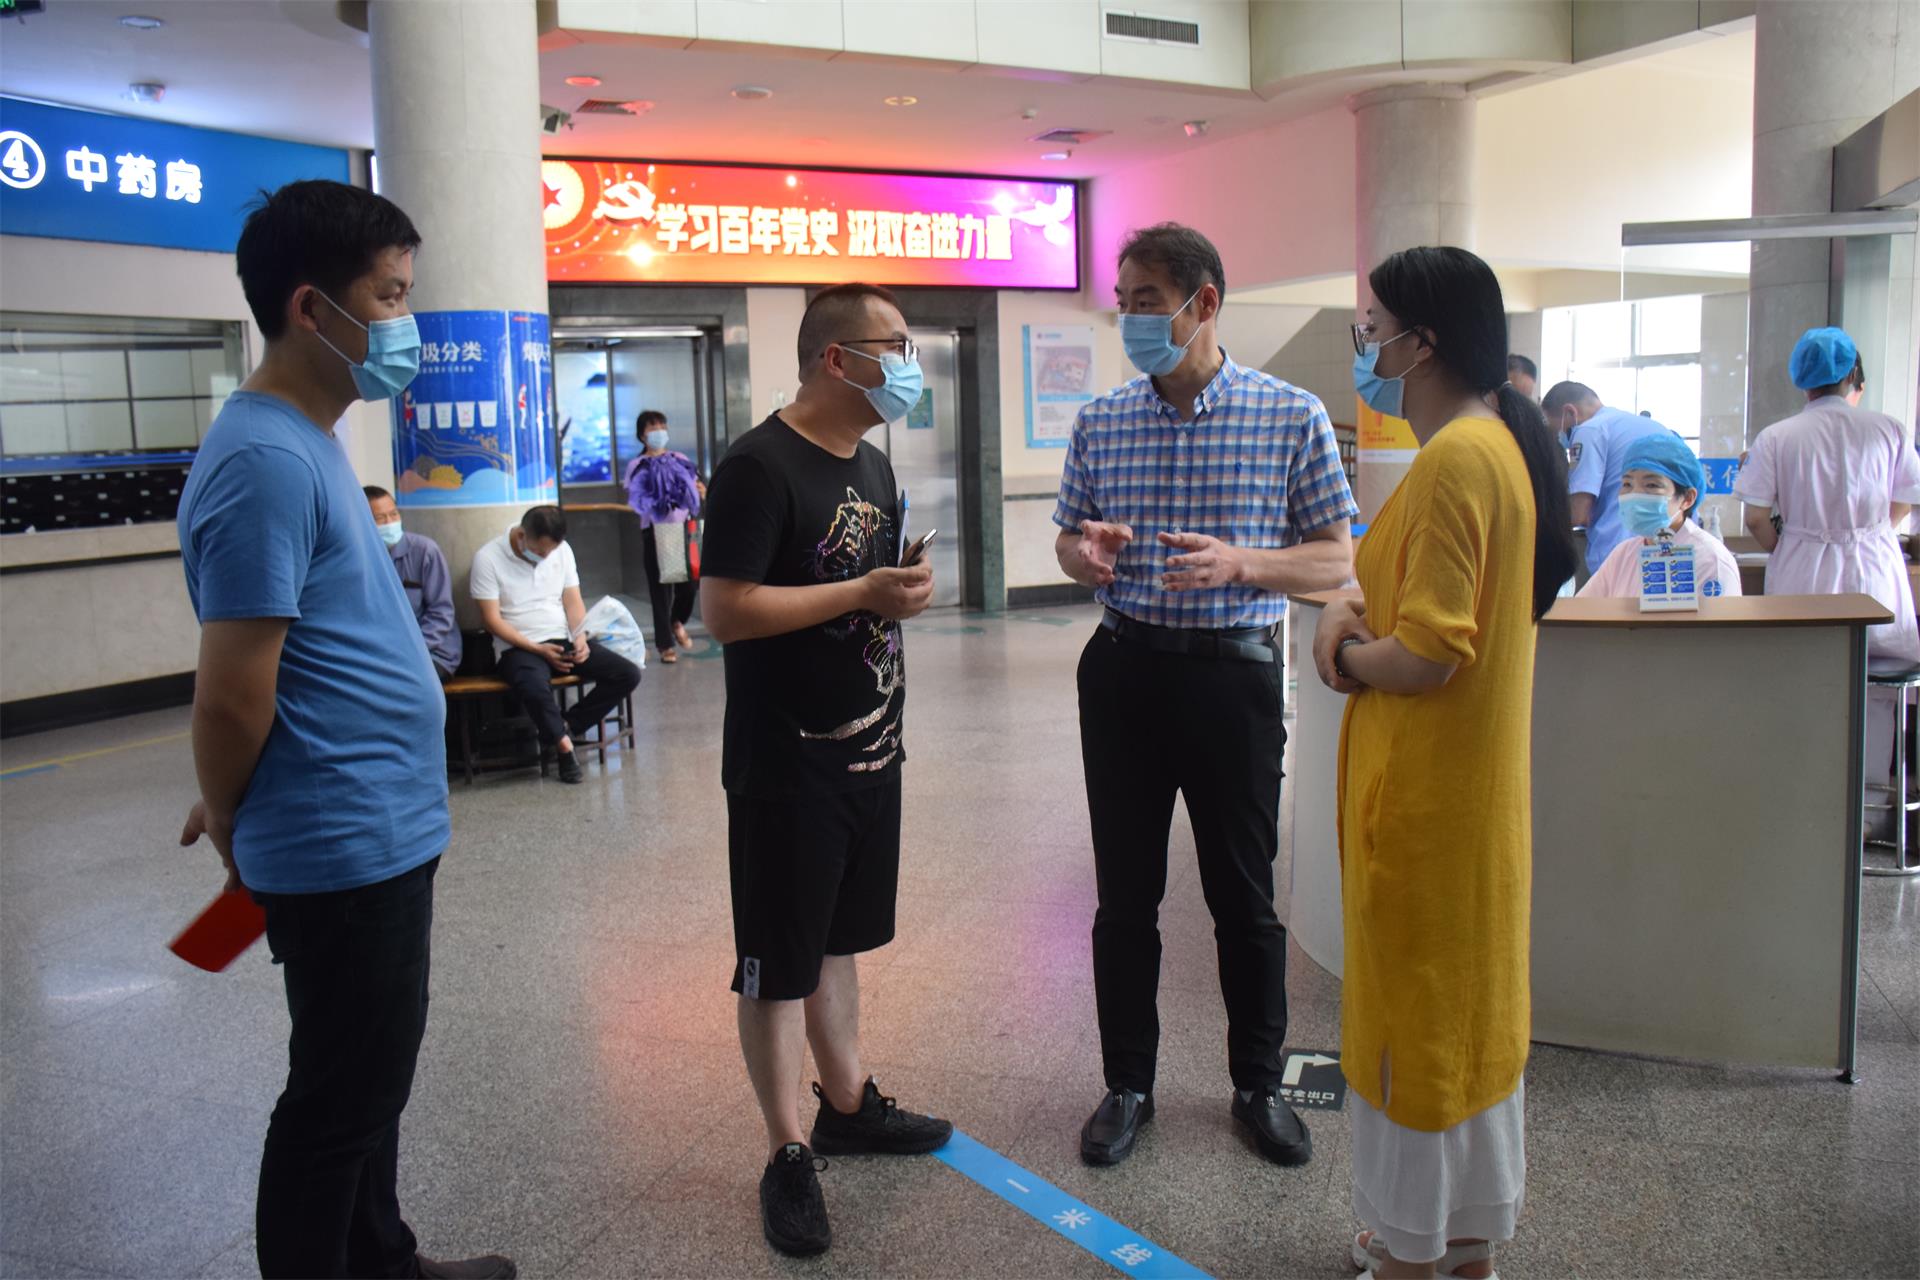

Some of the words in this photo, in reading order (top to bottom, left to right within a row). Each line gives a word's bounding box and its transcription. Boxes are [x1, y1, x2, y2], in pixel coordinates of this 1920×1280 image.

[65, 145, 203, 204] 中药房
[655, 203, 840, 256] 学习百年党史
[847, 209, 1013, 260] 汲取奋进力量
[420, 340, 482, 363] 圾分类
[1280, 1088, 1336, 1101] 安全出口
[1006, 1178, 1153, 1266] 一米线
